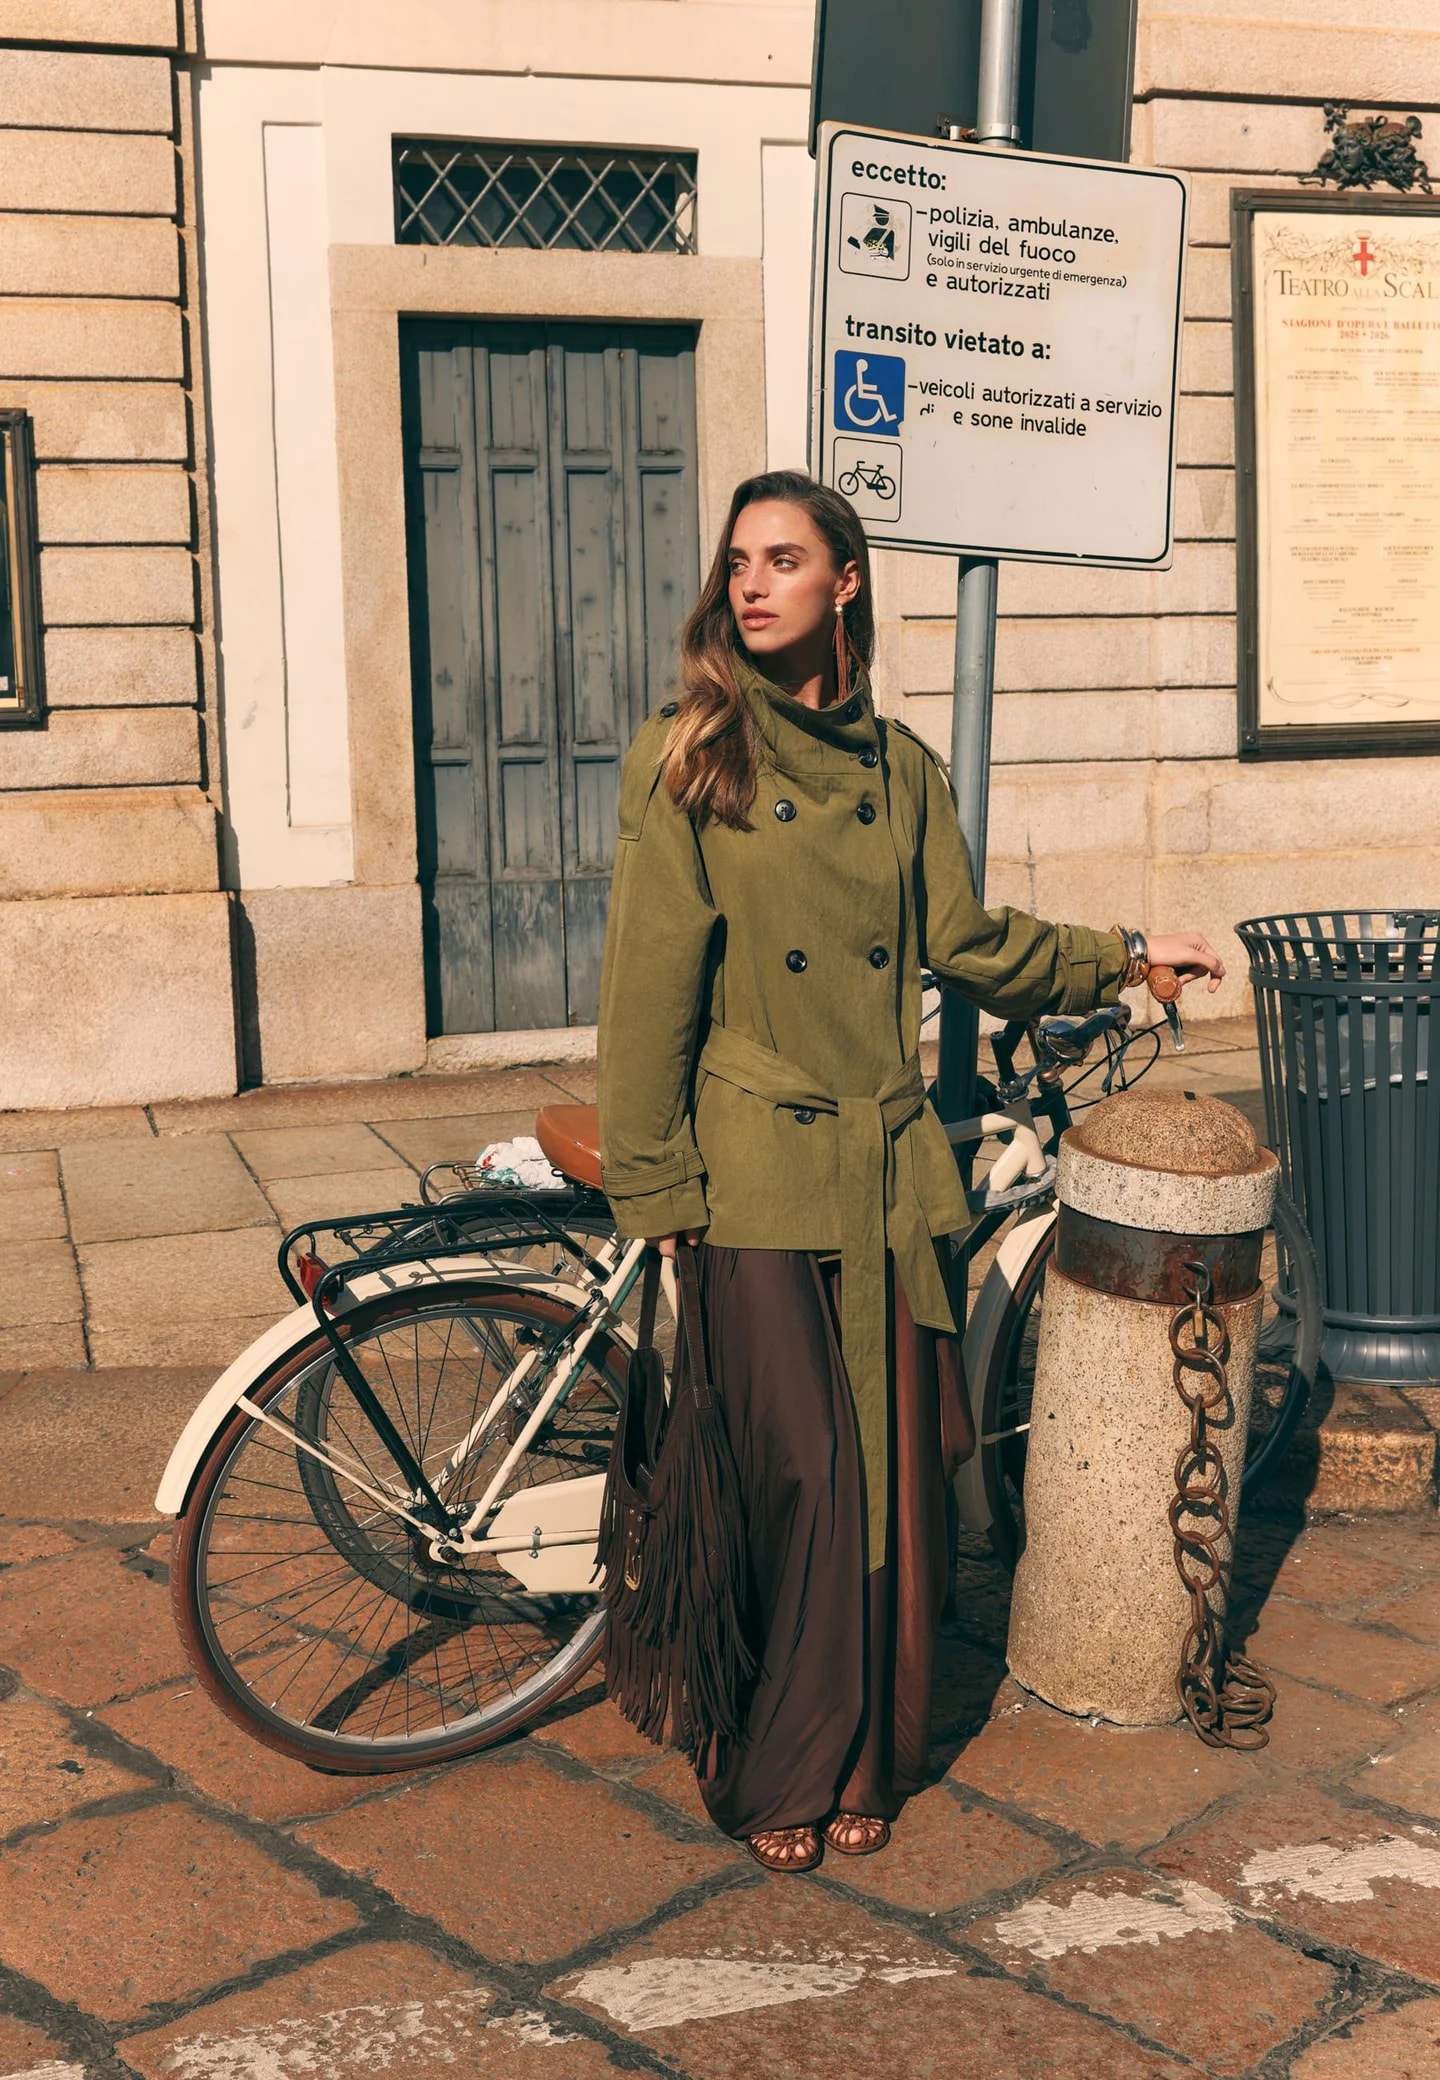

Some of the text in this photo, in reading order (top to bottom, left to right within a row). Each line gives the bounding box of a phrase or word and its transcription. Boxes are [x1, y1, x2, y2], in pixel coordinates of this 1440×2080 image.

[851, 161, 947, 191] eccetto:
[1008, 216, 1119, 244] ambulanze,
[929, 230, 1076, 263] vigili del fuoco
[926, 253, 1127, 288] (solo in servizio urgente di emergenza)
[1384, 272, 1440, 299] SCAL
[926, 273, 1051, 301] e autorizzati
[846, 315, 1051, 360] transito vietato a:
[982, 387, 1076, 410] autorizzati
[1080, 399, 1091, 412] a
[1095, 398, 1162, 418] servizio
[1020, 413, 1087, 437] invalide
